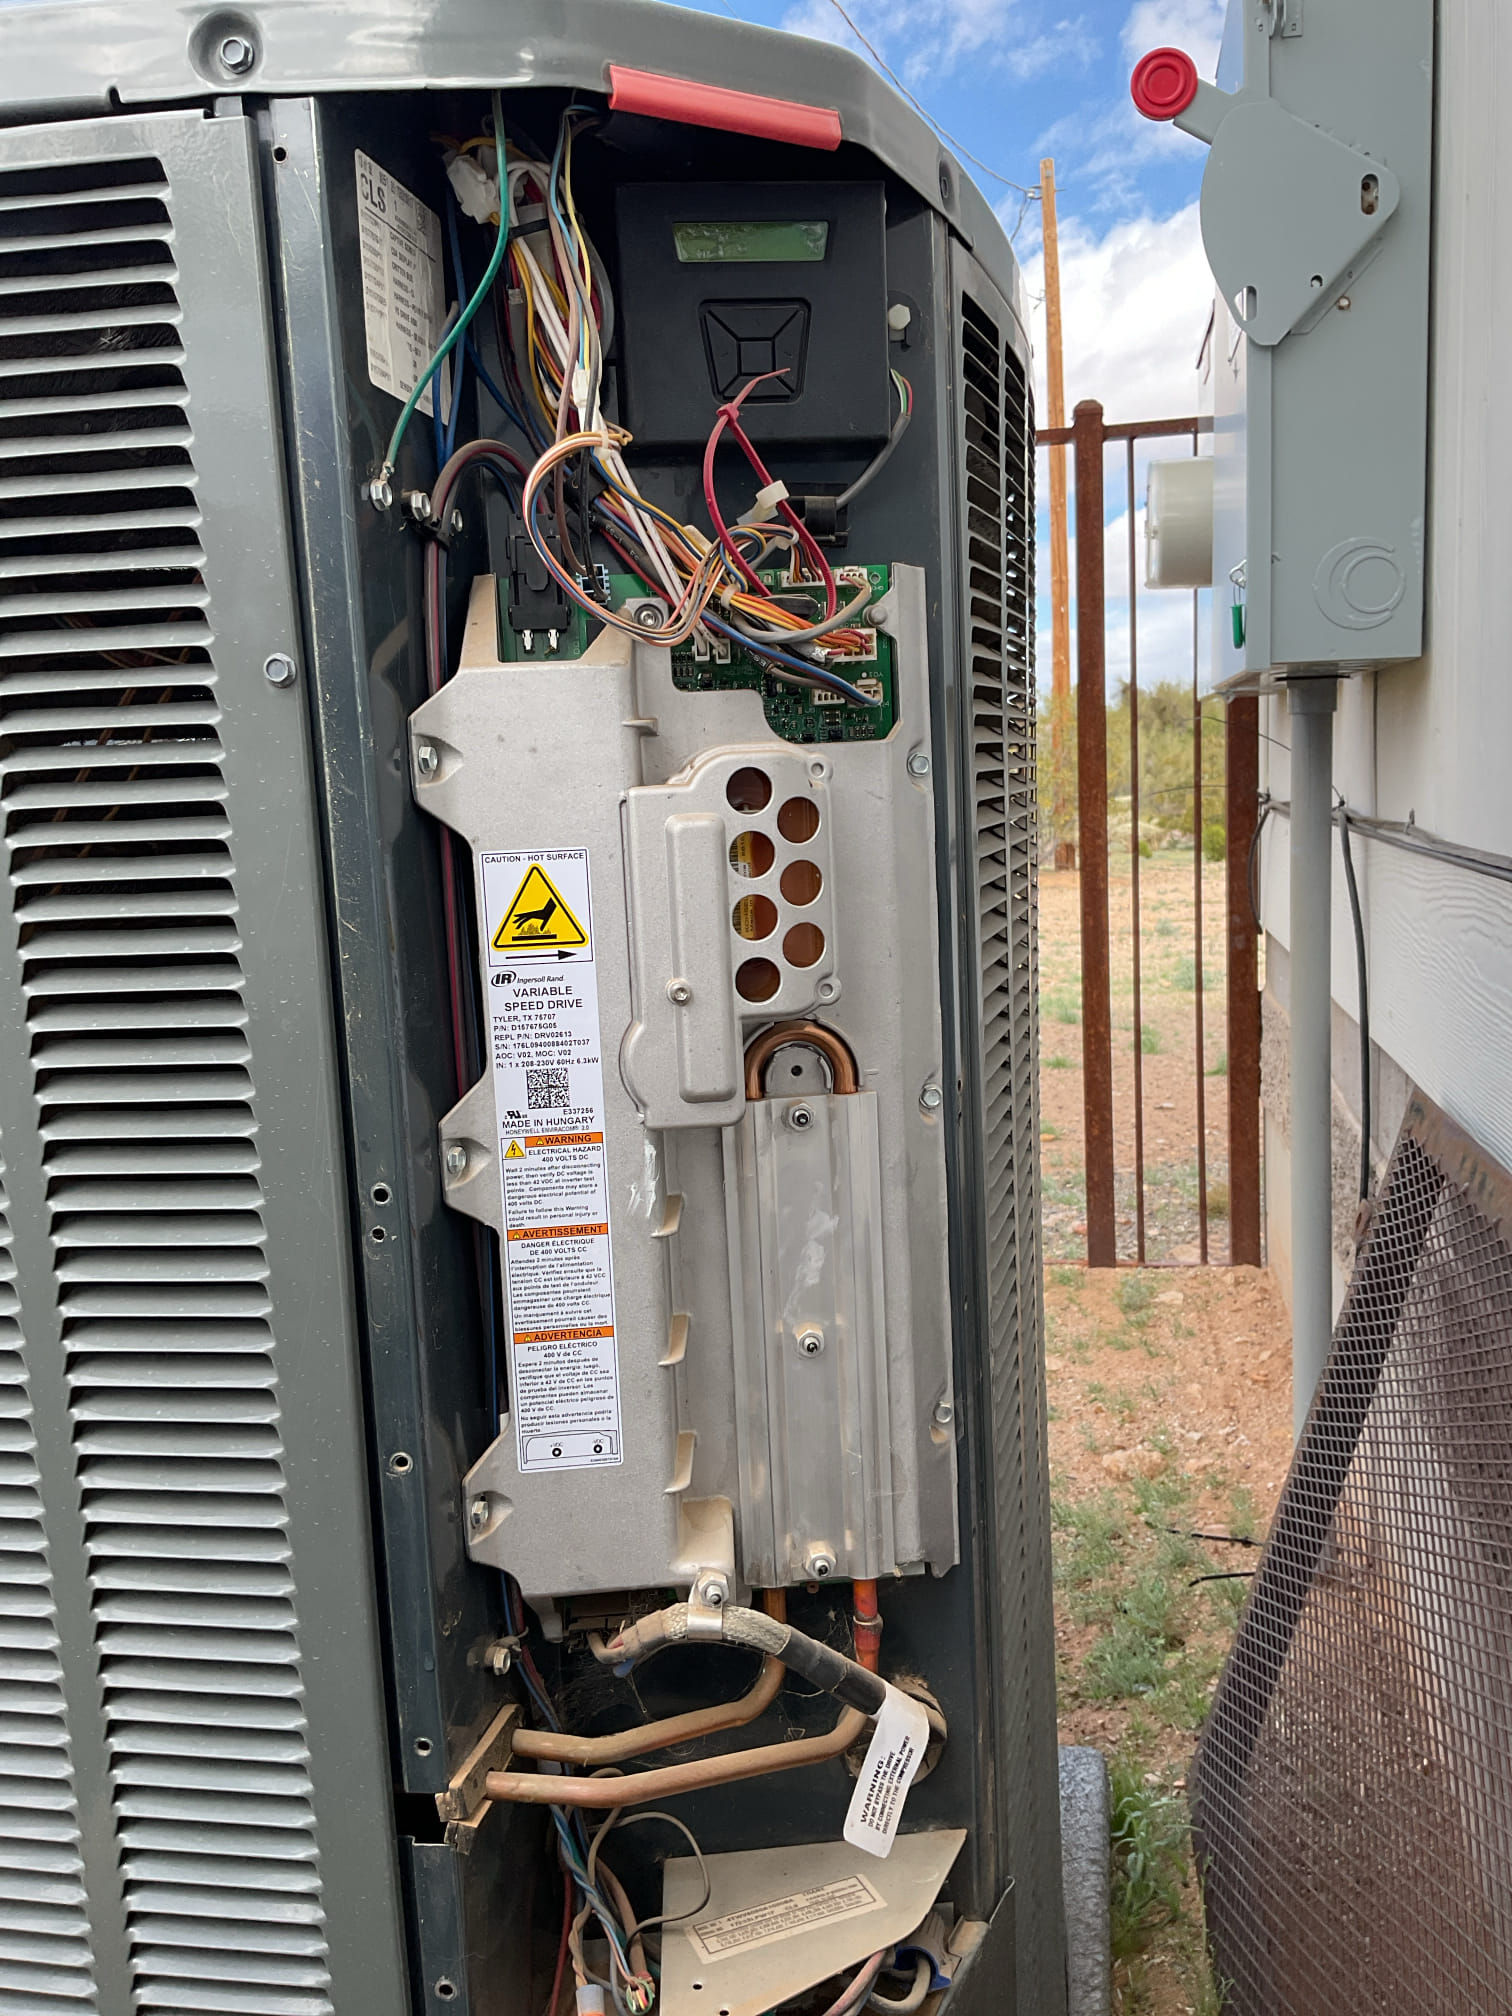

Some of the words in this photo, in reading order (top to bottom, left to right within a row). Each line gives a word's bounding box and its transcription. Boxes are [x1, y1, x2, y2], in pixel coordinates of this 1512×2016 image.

[361, 173, 386, 213] CLS
[485, 856, 520, 864] CAUTION
[546, 852, 584, 860] SURFACE
[516, 976, 545, 984] Ingersoll
[512, 985, 572, 997] VARIABLE
[504, 1000, 543, 1011] SPEED
[547, 998, 582, 1009] DRIVE
[492, 1015, 520, 1023] TYLER,
[520, 1059, 554, 1067] 208-230V
[502, 1119, 530, 1128] MADE
[546, 1115, 594, 1126] HUNGARY
[545, 1134, 591, 1144] WARNING
[528, 1147, 570, 1155] ELECTRICAL
[522, 1225, 602, 1238] AVERTISSEMENT
[533, 1328, 601, 1341] ADVERTENCIA
[527, 1344, 557, 1352] PELIGRO
[874, 1782, 884, 1805] BYPASS
[886, 1752, 895, 1768] DRIVE
[878, 1785, 891, 1821] CONNECTING
[888, 1757, 902, 1784] EXTERNAL
[899, 1736, 910, 1755] POWER
[882, 1807, 893, 1834] DIRECTLY
[896, 1747, 914, 1784] COMPRESSOR
